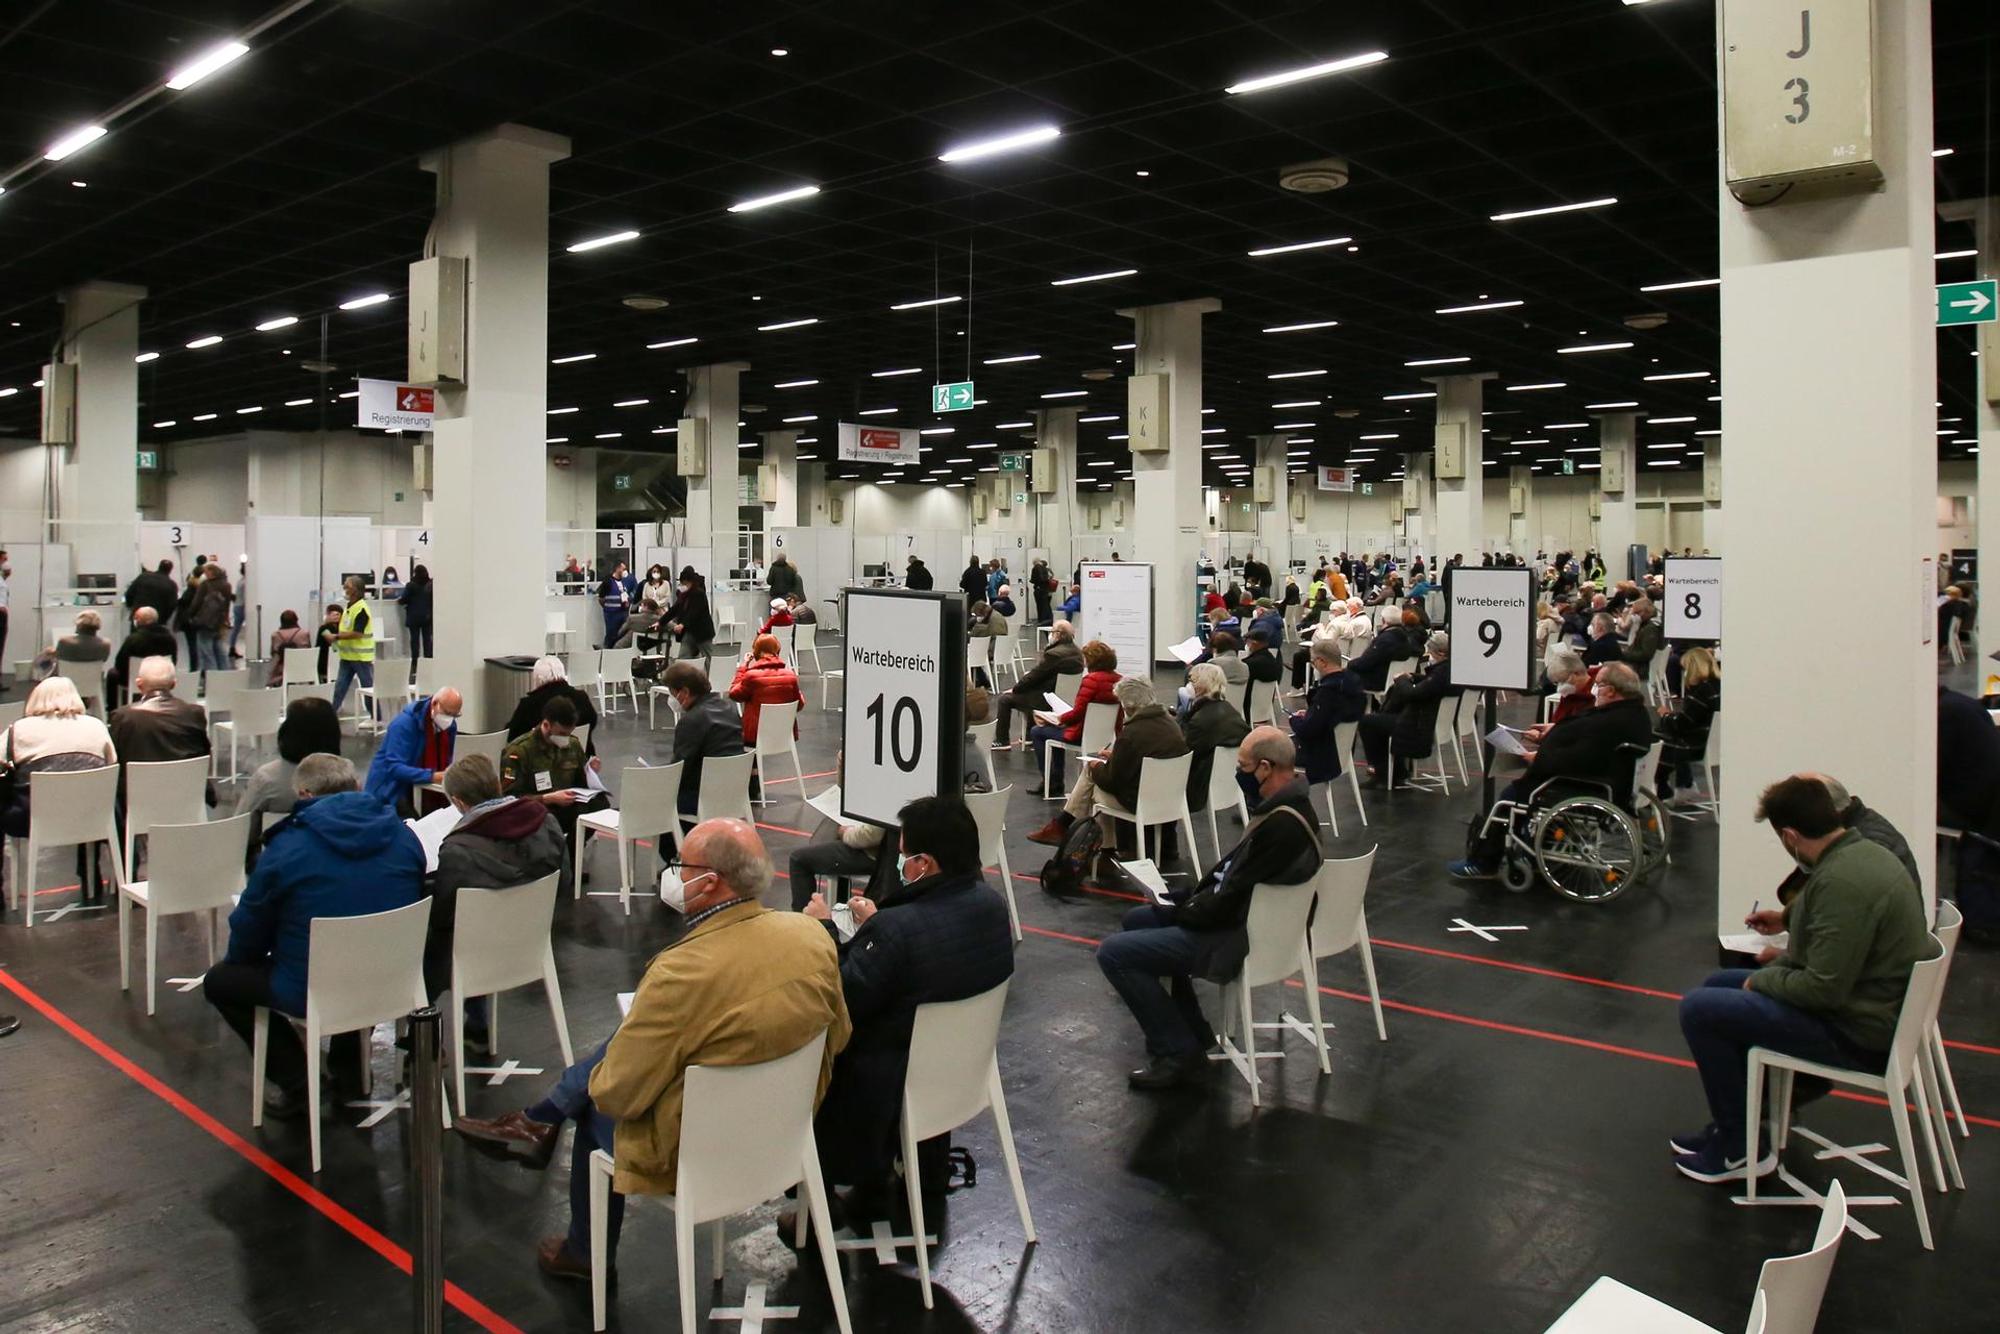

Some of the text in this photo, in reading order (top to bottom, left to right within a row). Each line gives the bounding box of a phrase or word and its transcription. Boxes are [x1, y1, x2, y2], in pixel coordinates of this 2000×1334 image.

[1786, 9, 1810, 59] J
[1784, 77, 1810, 124] 3
[1832, 144, 1857, 157] M-2
[421, 310, 427, 332] J
[371, 412, 431, 428] Registrierung
[1139, 405, 1148, 420] K
[1140, 424, 1146, 437] 4
[1444, 446, 1450, 456] L
[171, 526, 182, 544] 3
[418, 530, 429, 546] 4
[616, 532, 625, 547] 5
[776, 534, 783, 548] 6
[907, 535, 914, 548] 7
[1017, 537, 1023, 549] 8
[1456, 596, 1525, 608] Wartebereich
[1684, 593, 1702, 619] 8
[1478, 619, 1502, 658] 9
[852, 646, 935, 673] Wartebereich
[866, 692, 923, 773] 10
